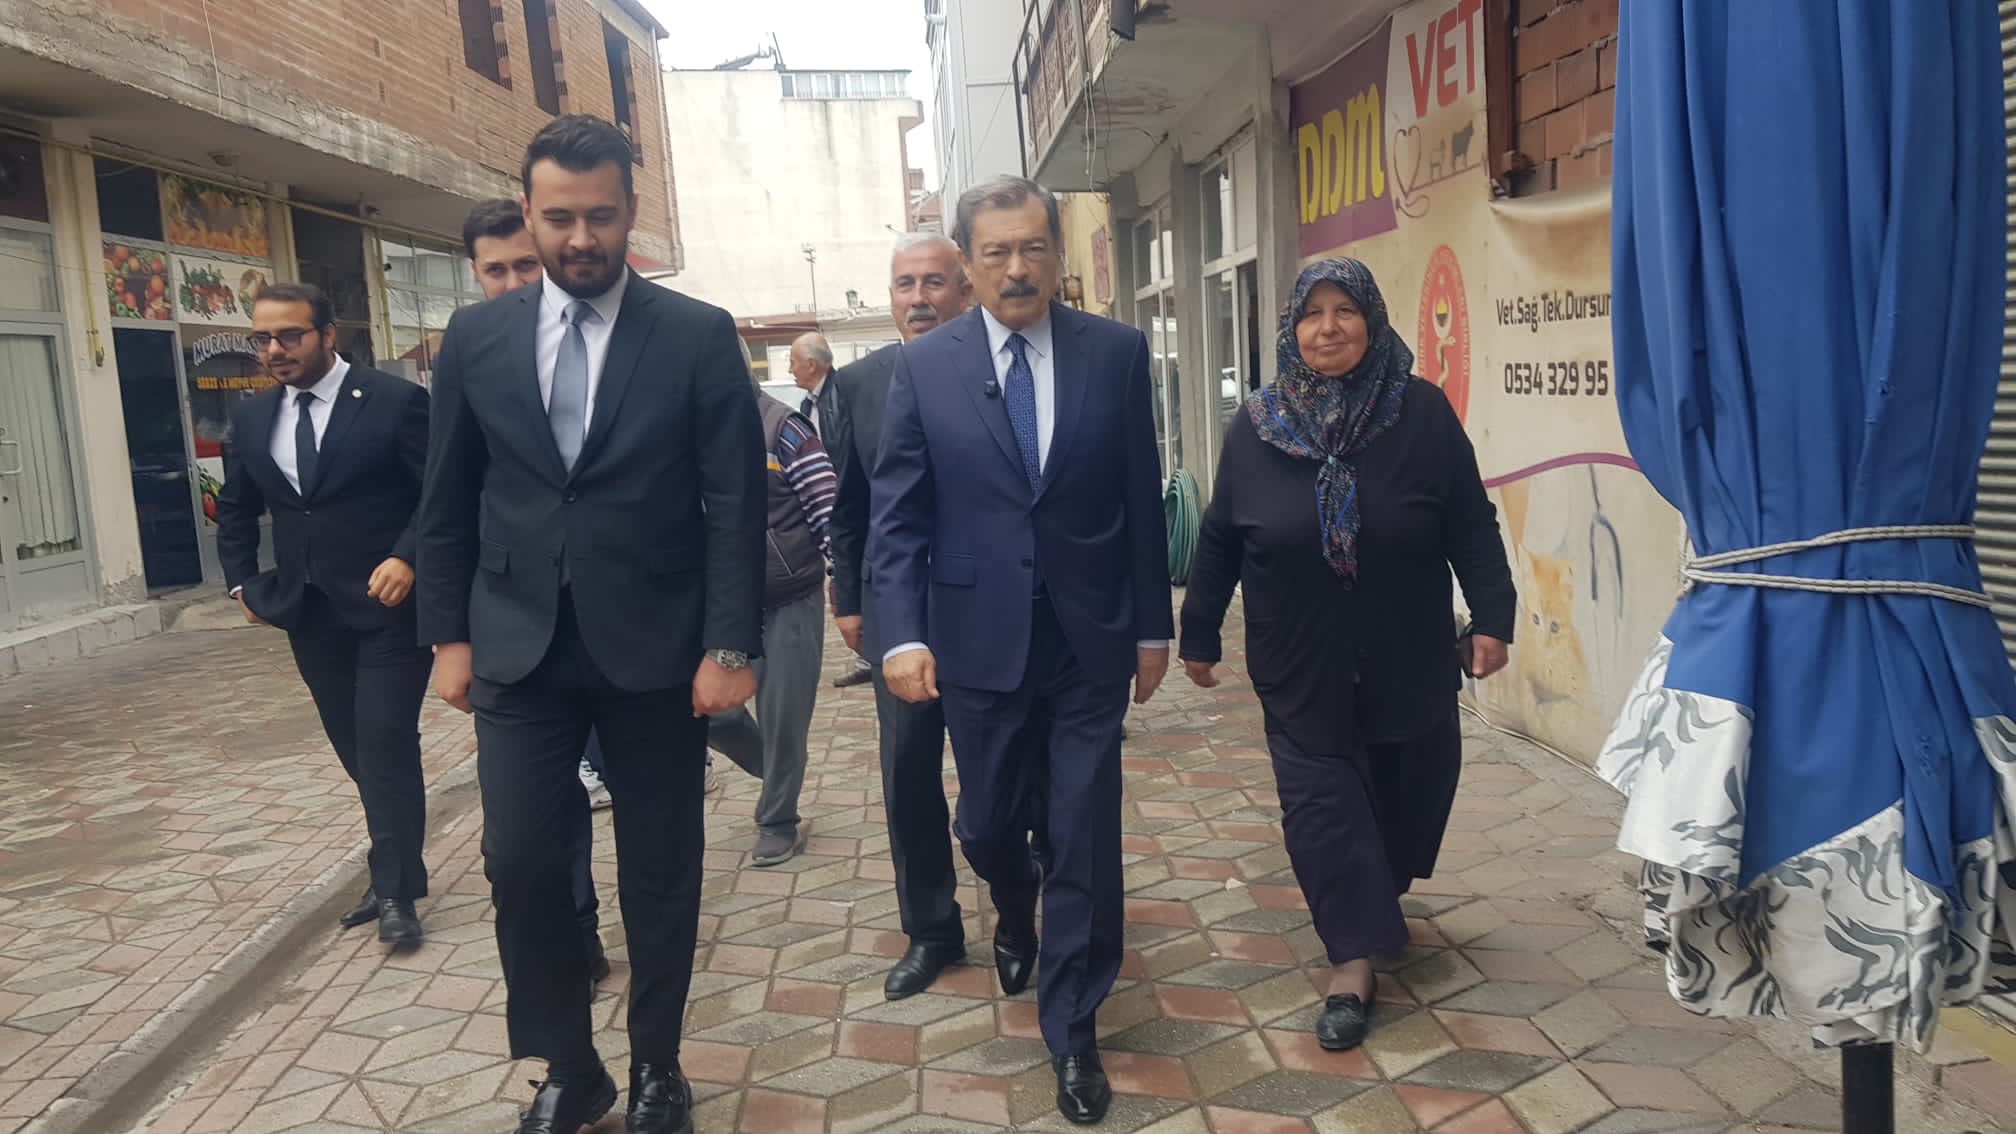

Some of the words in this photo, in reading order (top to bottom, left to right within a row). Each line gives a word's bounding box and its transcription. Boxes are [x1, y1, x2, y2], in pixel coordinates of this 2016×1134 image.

[1406, 0, 1481, 119] VET
[1504, 362, 1543, 395] 0534
[1547, 361, 1580, 396] 329
[1584, 360, 1609, 396] 95
